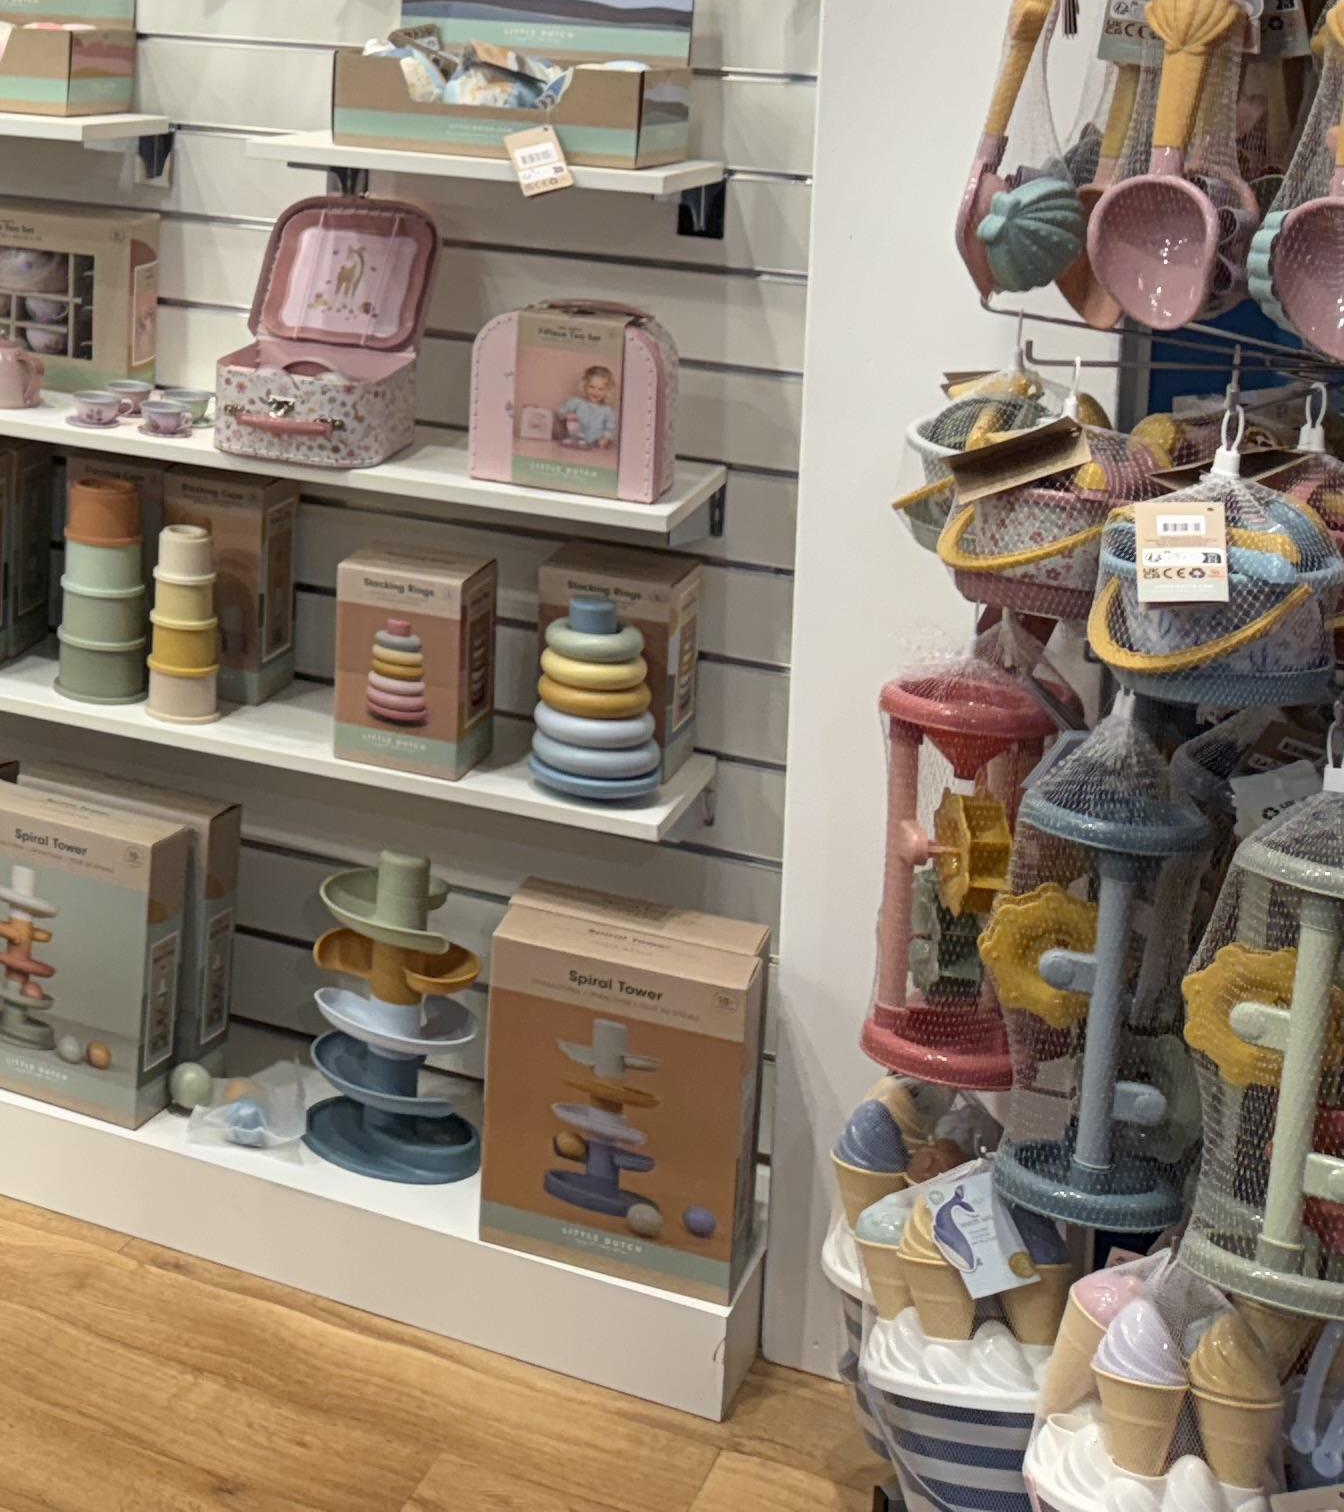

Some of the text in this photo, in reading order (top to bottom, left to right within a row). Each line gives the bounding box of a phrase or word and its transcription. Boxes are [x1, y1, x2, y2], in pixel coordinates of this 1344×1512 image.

[363, 577, 436, 599] Stacking Rings
[567, 580, 643, 603] Stacking Rings
[15, 828, 88, 857] Spiral Tower
[568, 970, 664, 1002] Spiral Tower
[604, 1235, 644, 1254] DUTCH
